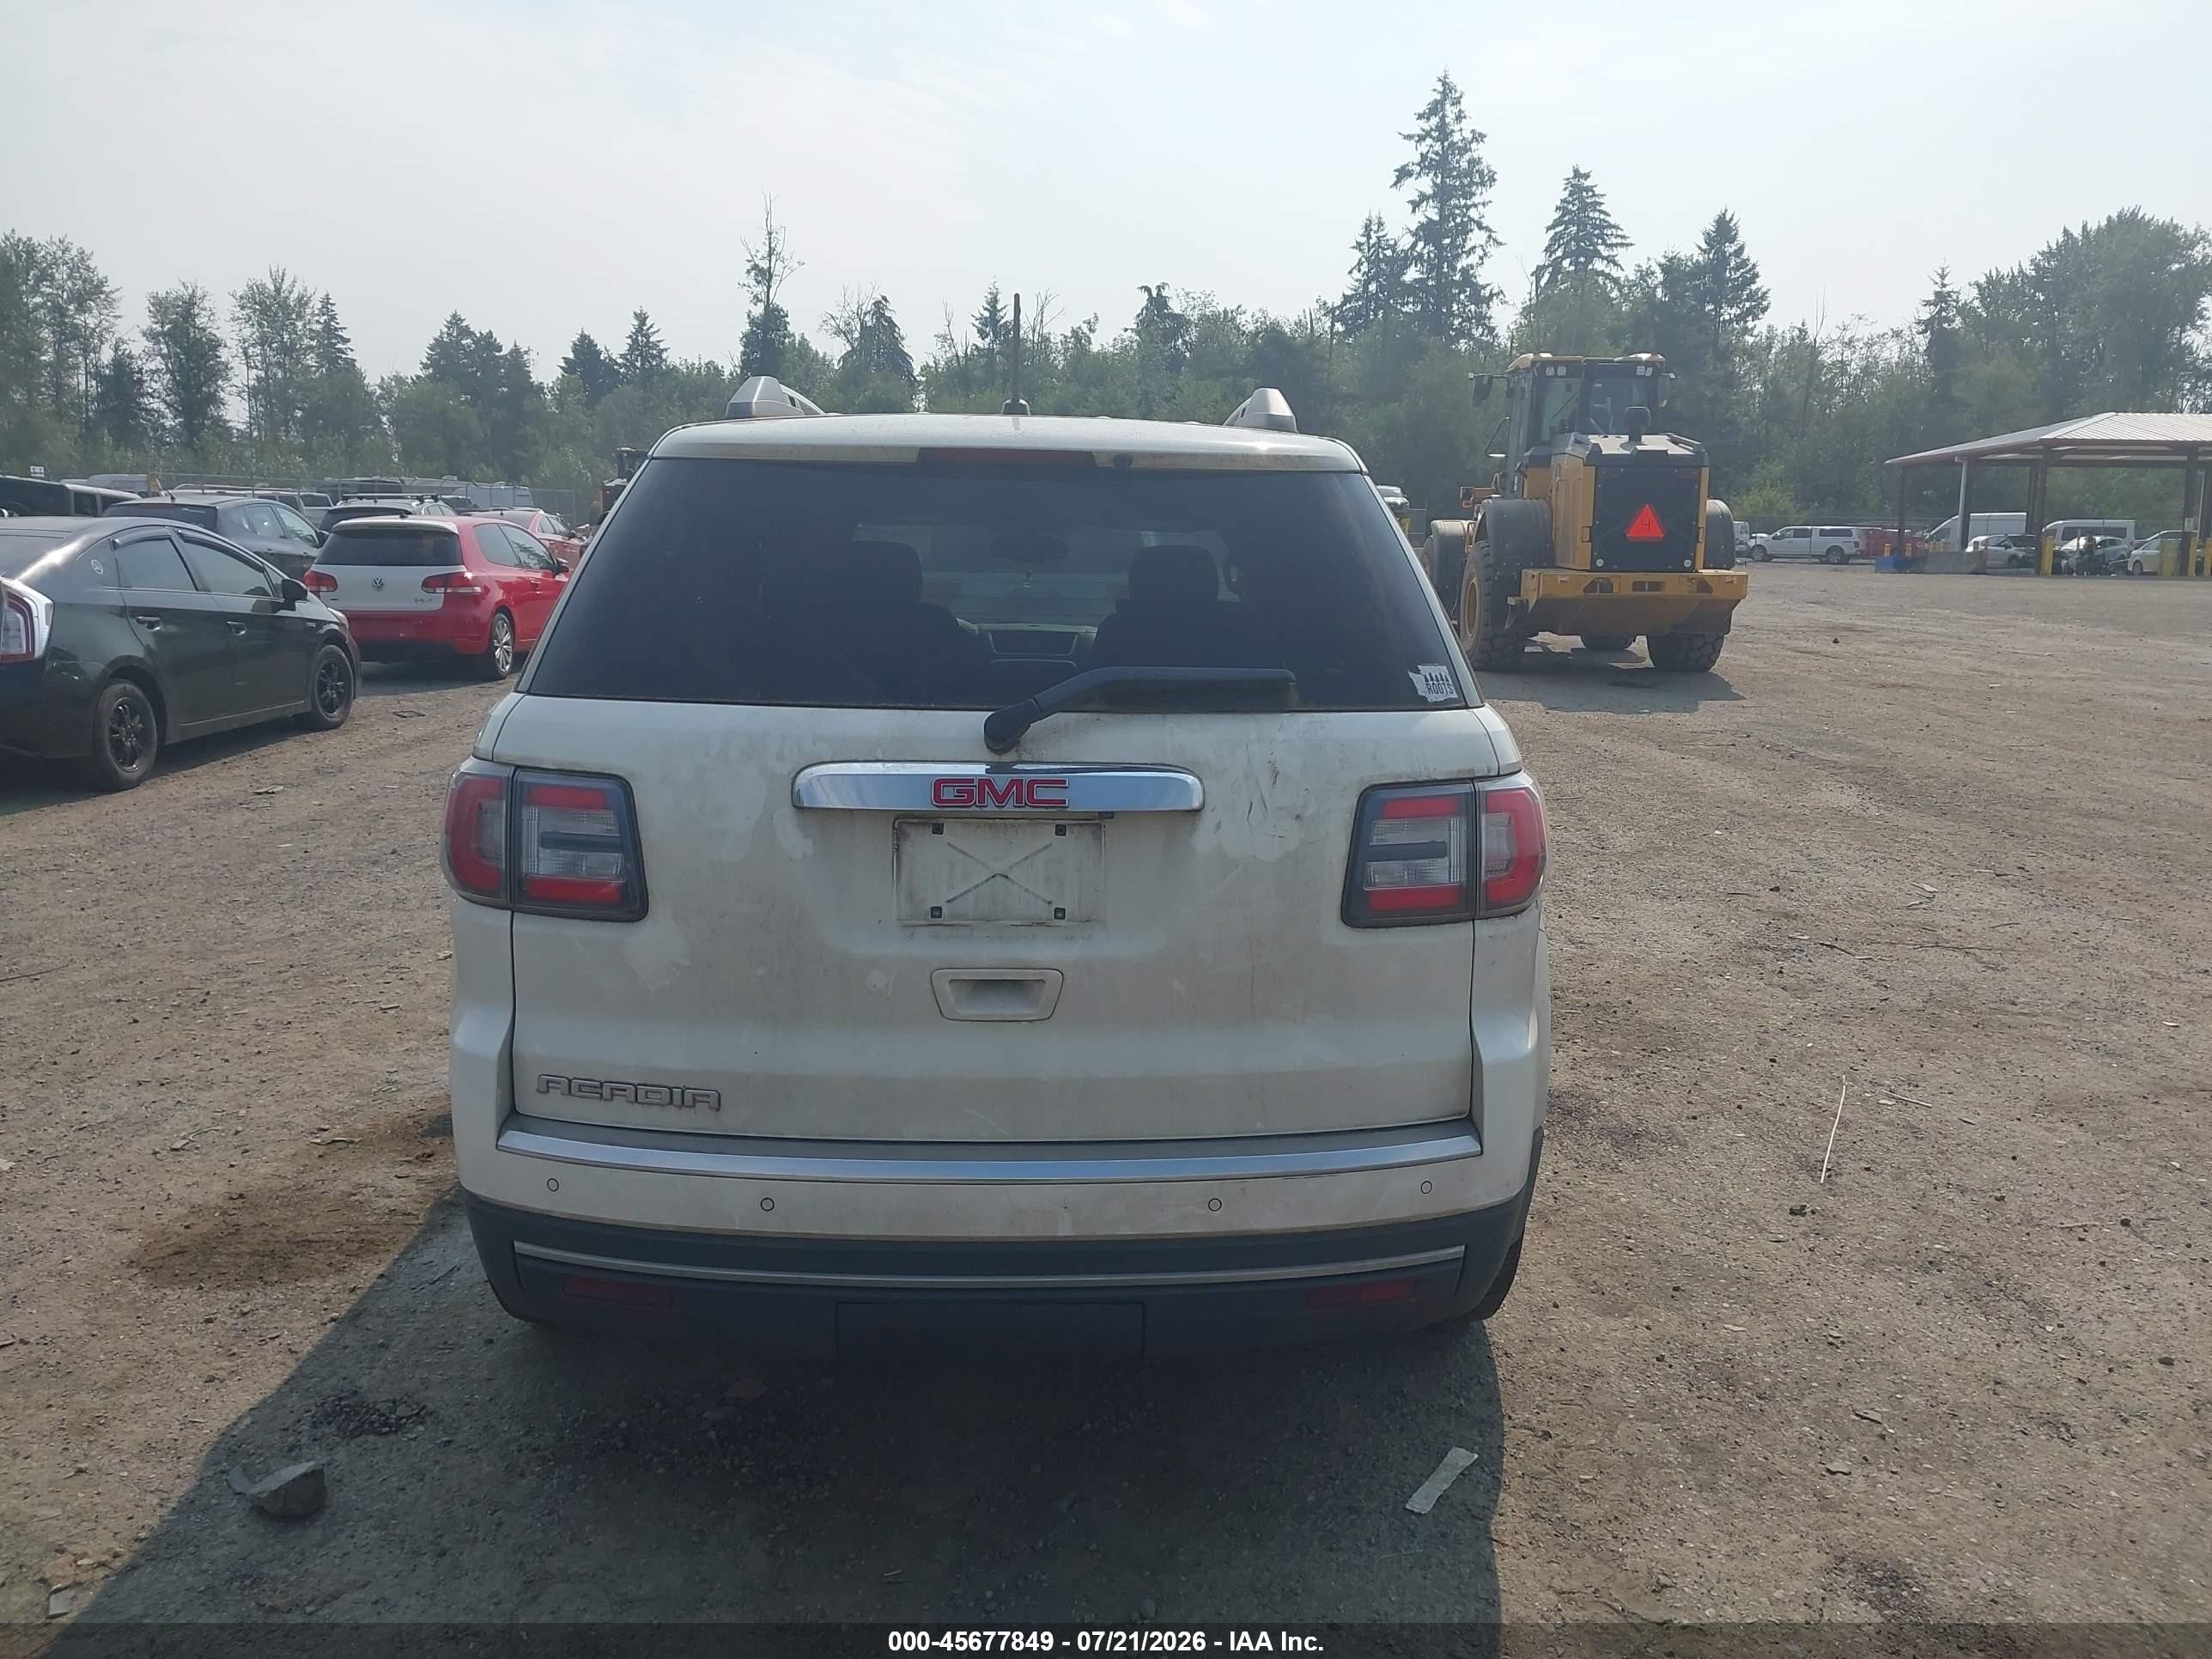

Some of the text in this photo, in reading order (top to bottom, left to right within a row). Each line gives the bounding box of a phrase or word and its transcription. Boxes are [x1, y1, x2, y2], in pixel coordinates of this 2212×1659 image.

[1426, 683, 1454, 695] ROOTS
[932, 776, 1069, 808] GMC
[537, 1074, 720, 1112] ACADIA
